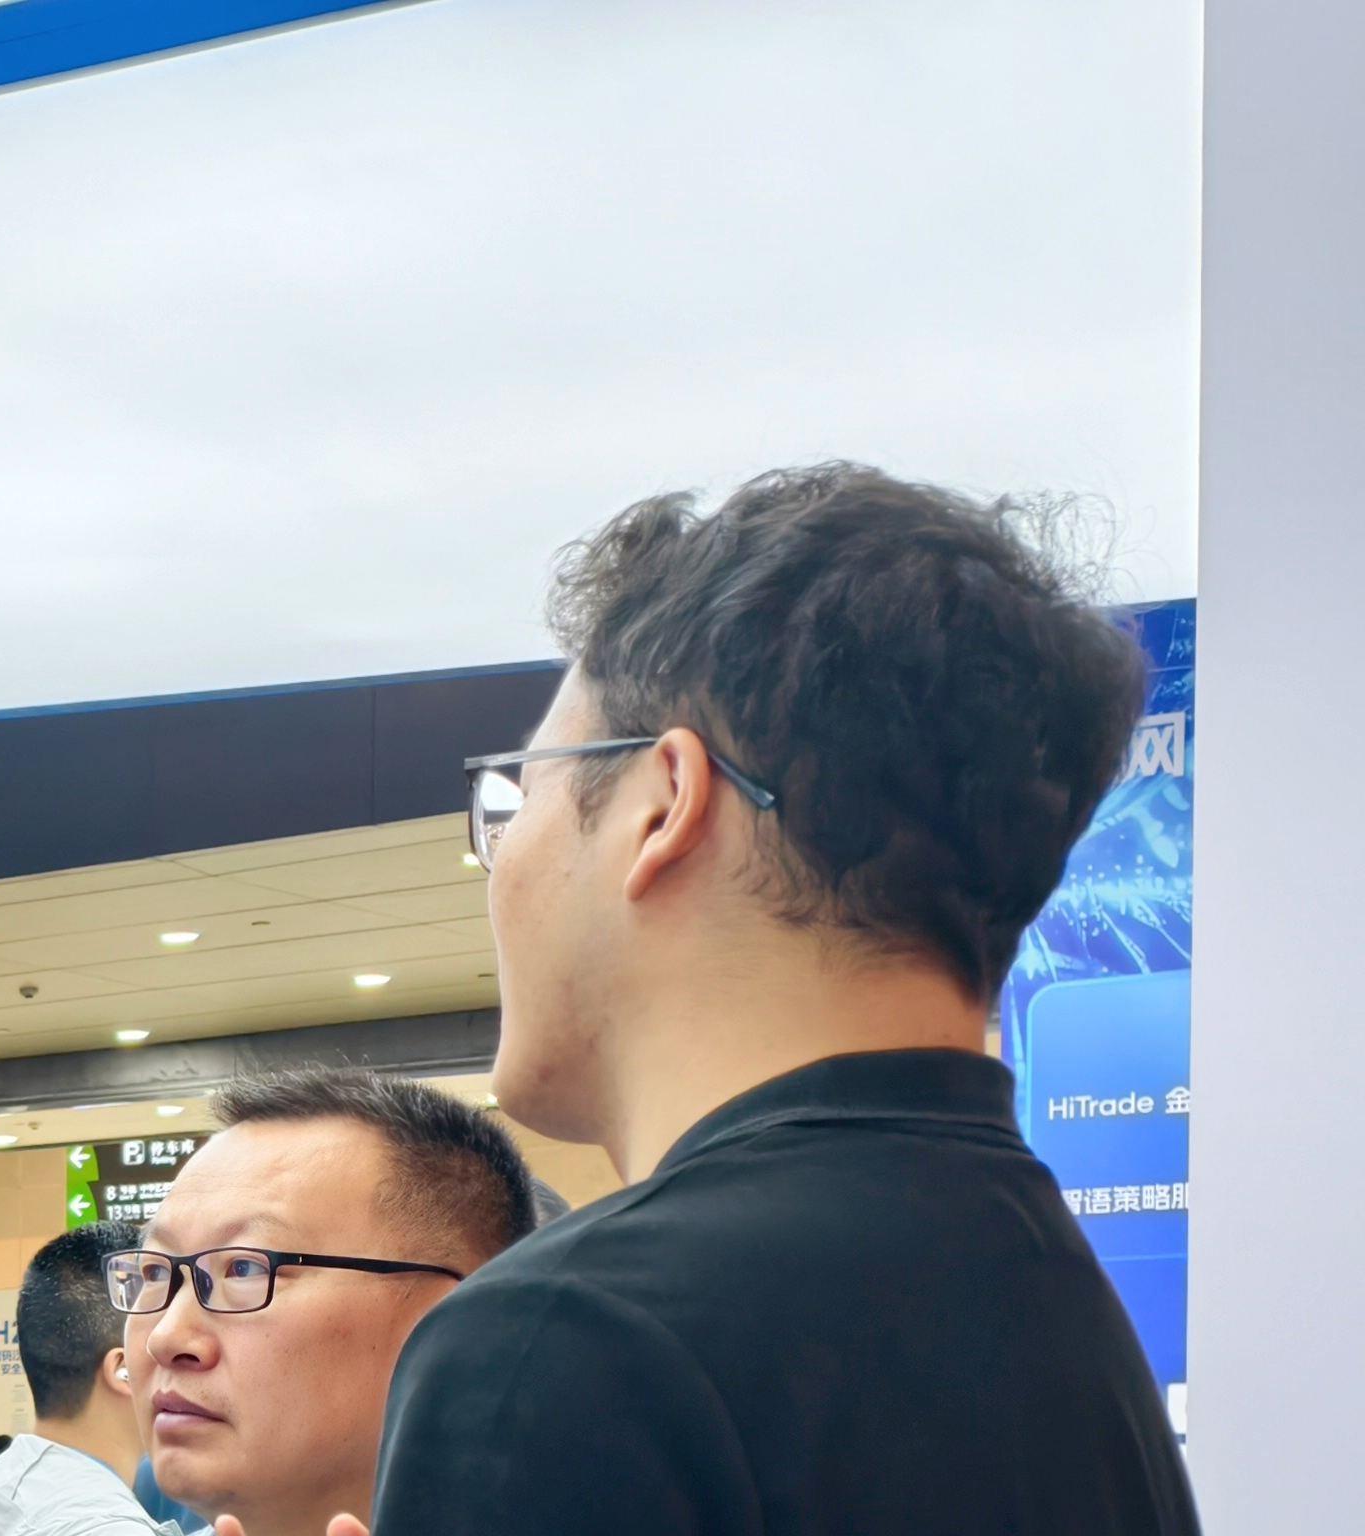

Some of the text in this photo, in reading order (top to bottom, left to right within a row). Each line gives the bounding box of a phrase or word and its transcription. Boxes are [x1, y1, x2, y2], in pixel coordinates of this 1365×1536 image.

[1048, 1085, 1190, 1121] HiTrade 金
[107, 1204, 123, 1220] 13
